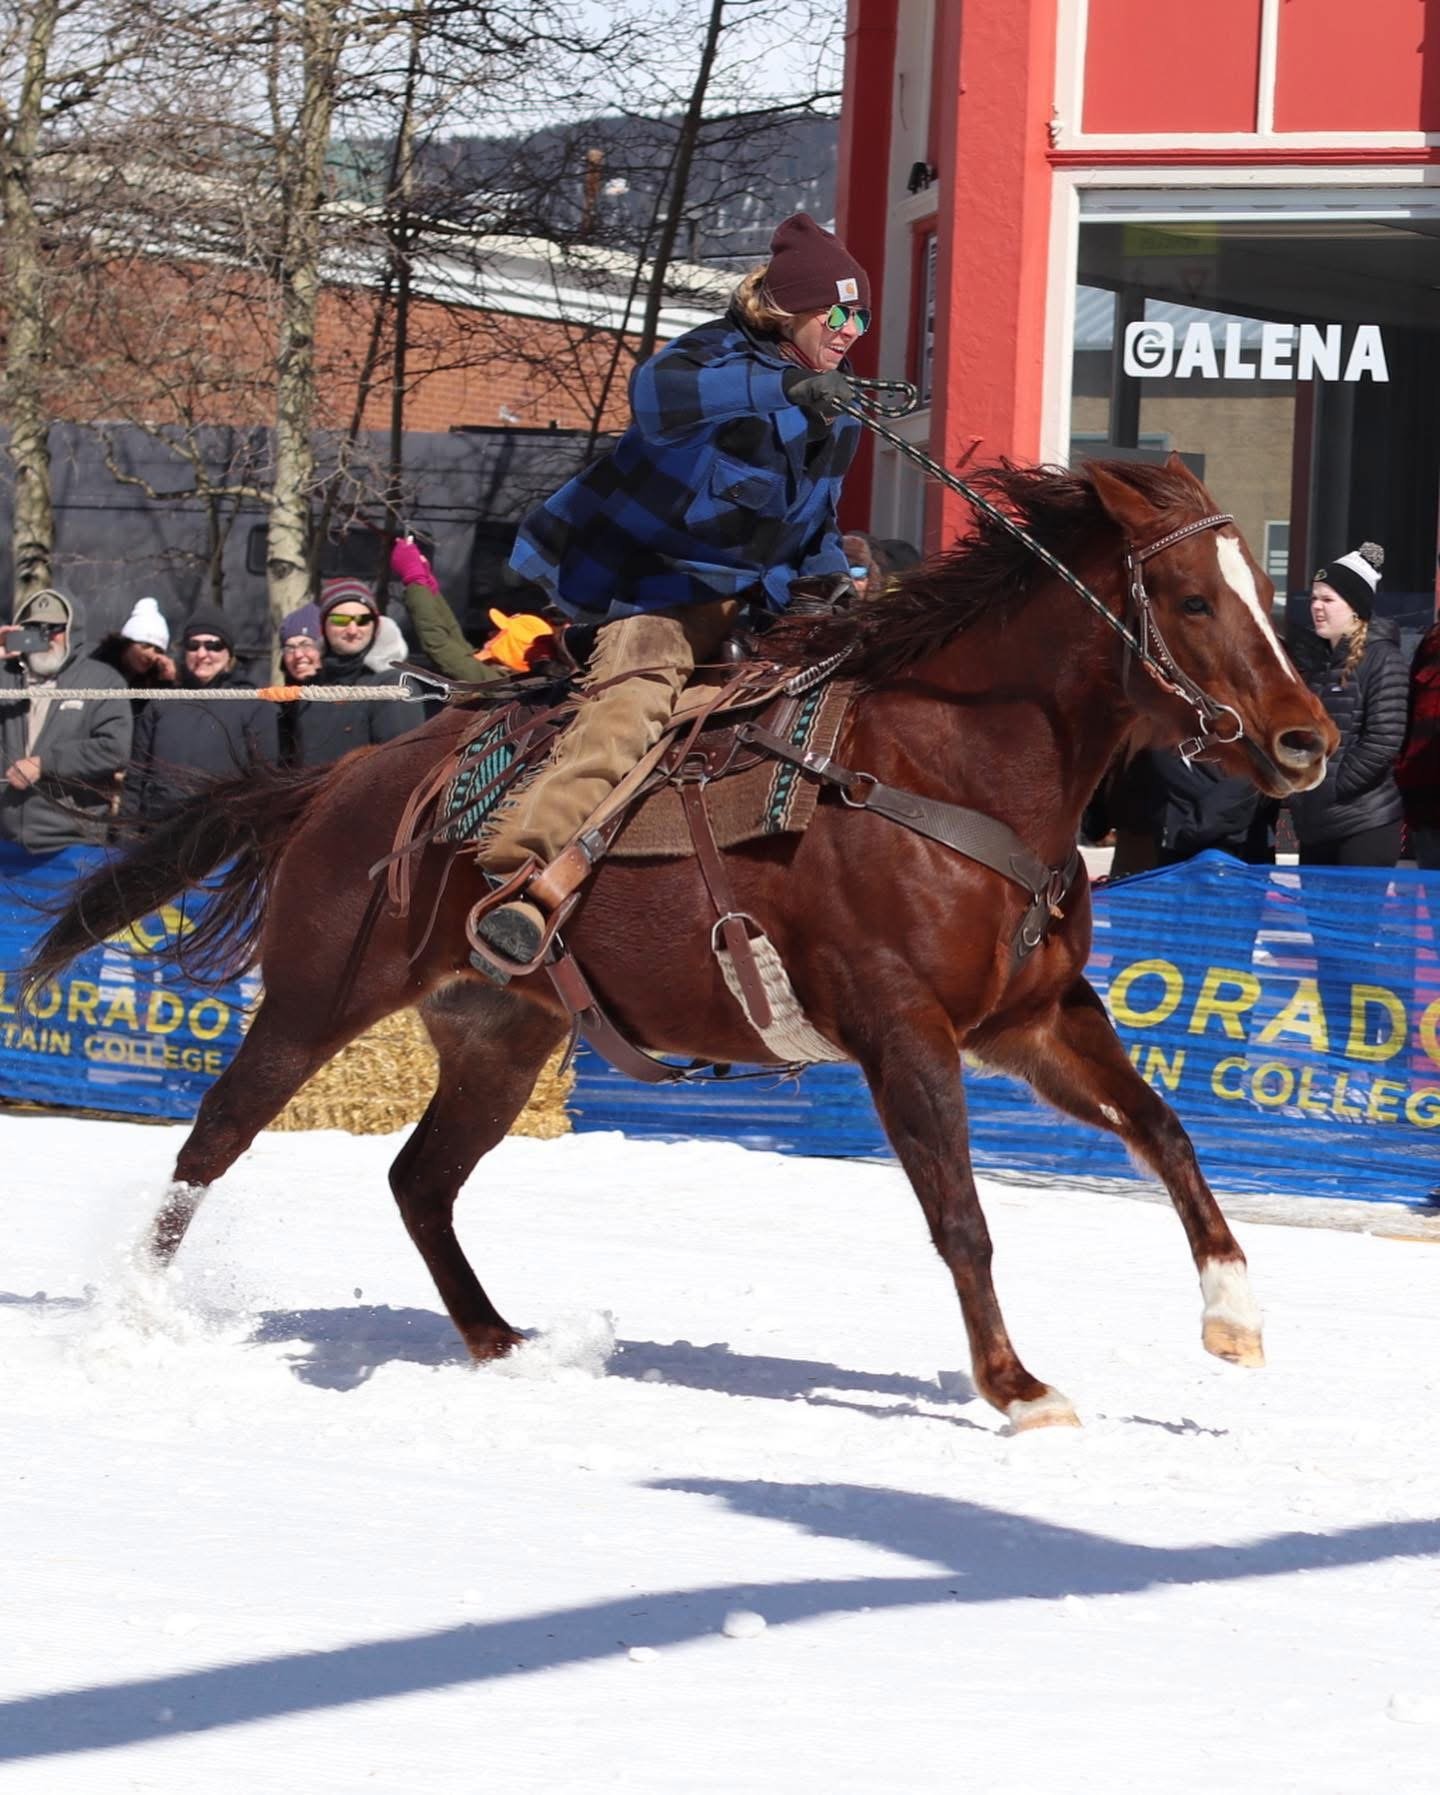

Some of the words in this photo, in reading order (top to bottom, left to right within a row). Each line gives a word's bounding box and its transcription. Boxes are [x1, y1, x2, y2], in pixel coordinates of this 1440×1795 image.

[1124, 321, 1390, 382] GALENA
[1108, 958, 1440, 1068] ORAD
[84, 1035, 223, 1076] COLLEGE
